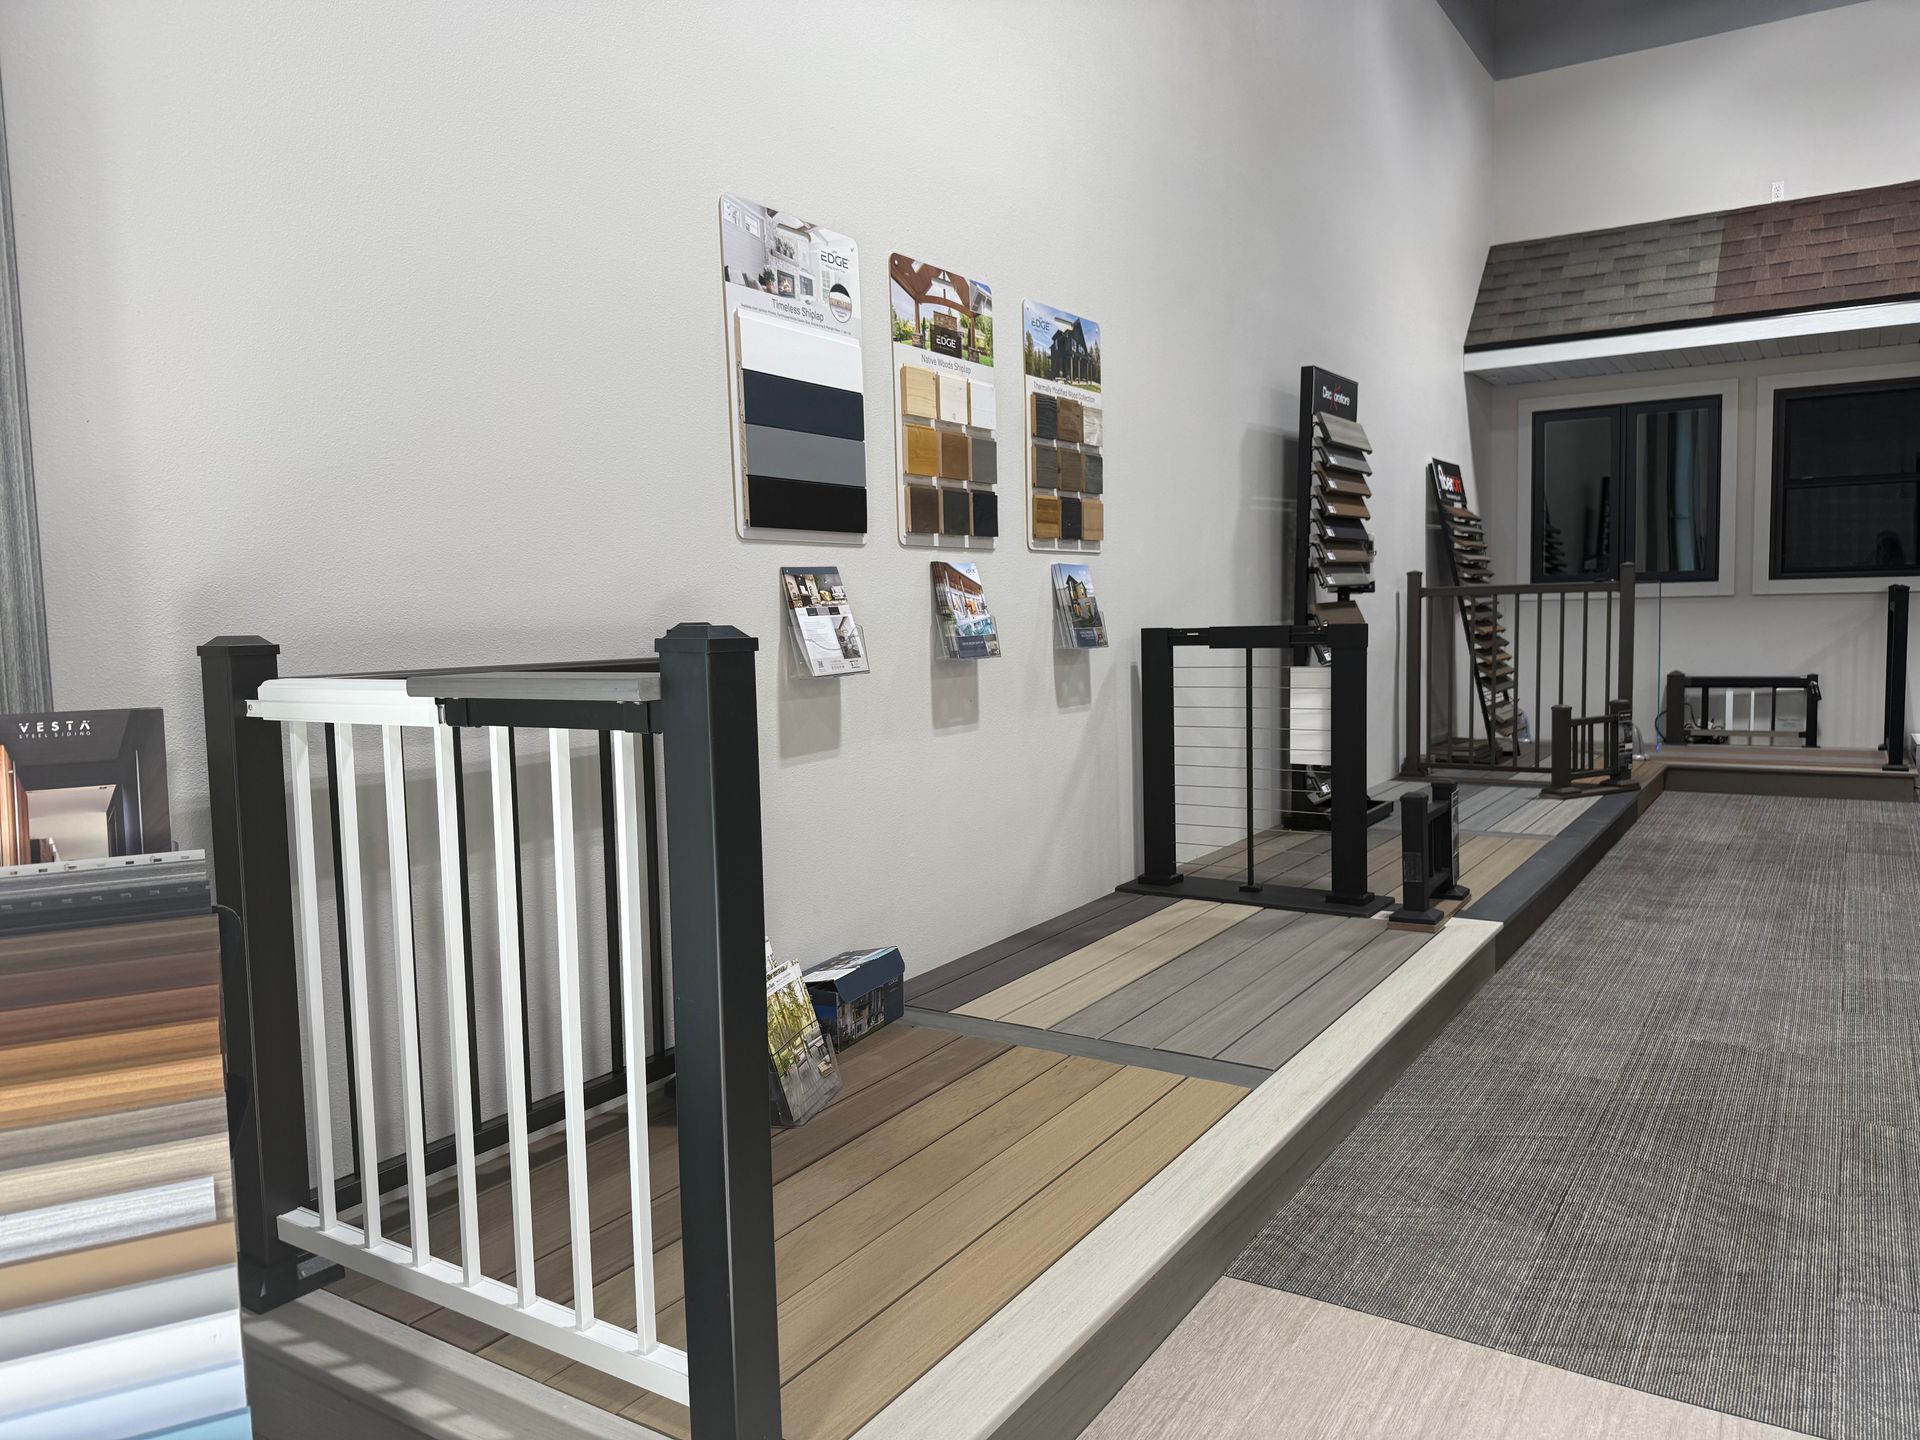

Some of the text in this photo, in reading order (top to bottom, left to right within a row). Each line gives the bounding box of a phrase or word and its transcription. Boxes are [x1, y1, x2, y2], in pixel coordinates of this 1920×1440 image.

[820, 250, 849, 270] EDGE
[771, 298, 801, 315] Timeless
[801, 306, 825, 323] Shiplap
[1031, 317, 1050, 332] EDGE
[936, 335, 956, 349] EDGE
[921, 354, 972, 375] Native Woods Shiplap
[18, 720, 91, 733] VESTA
